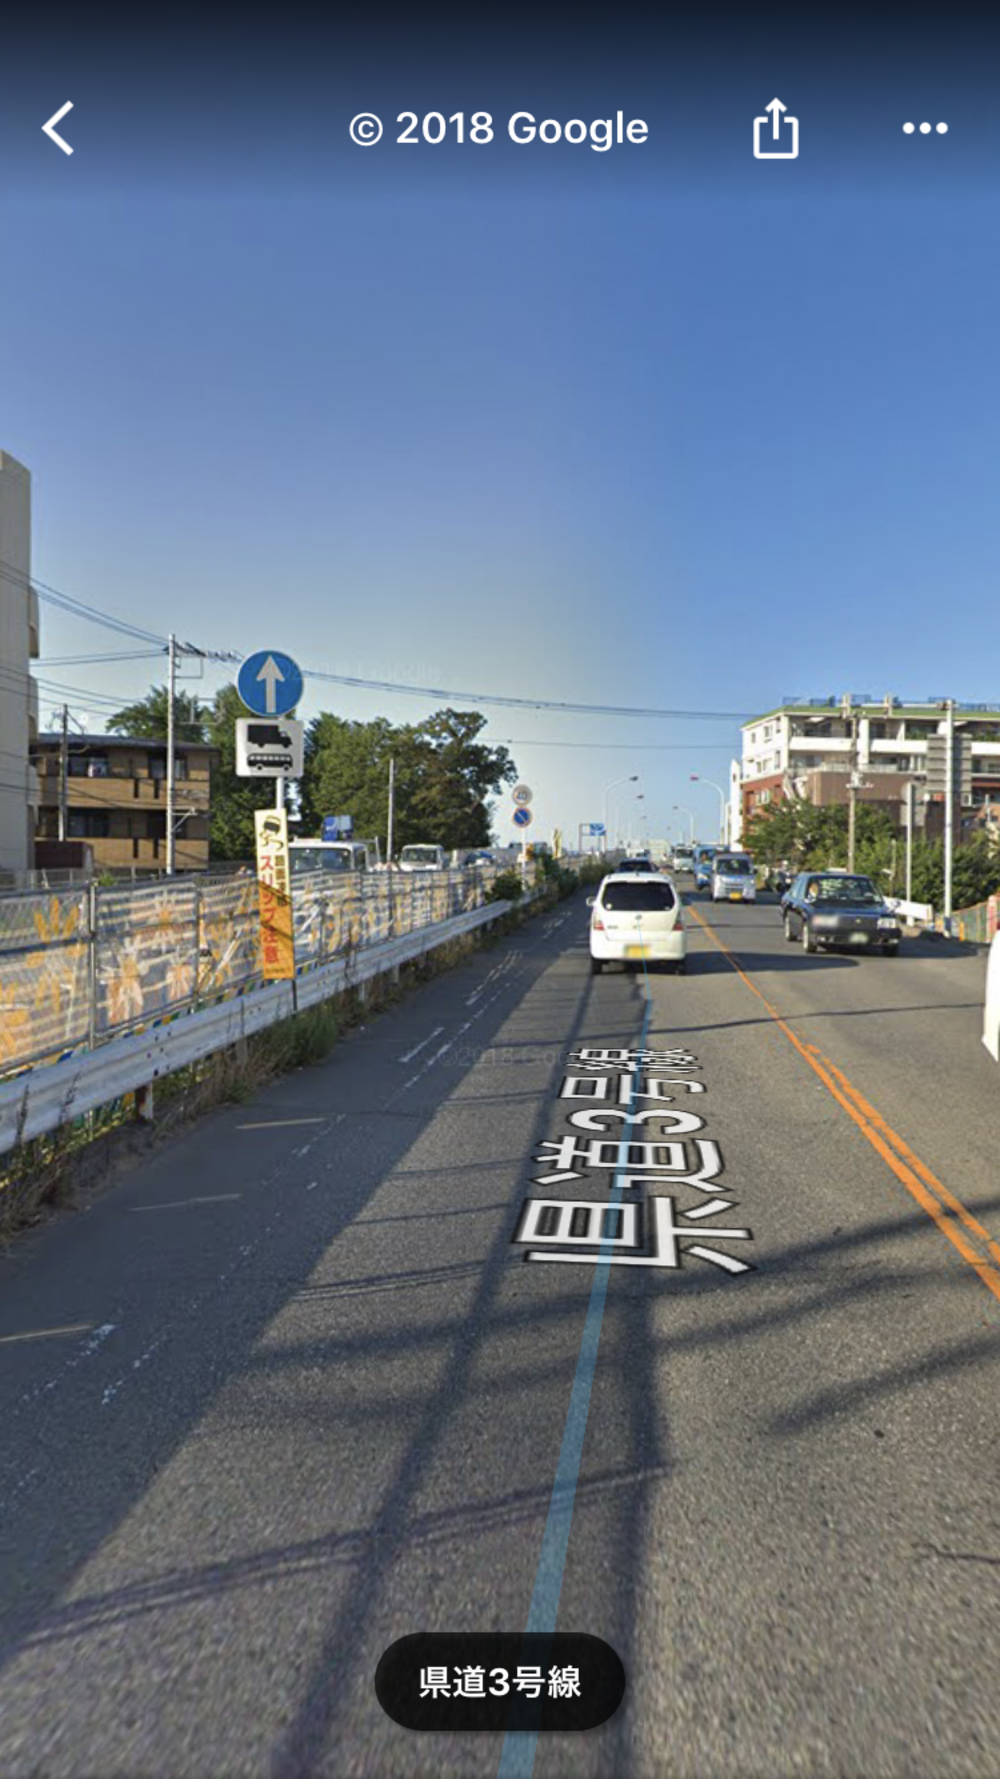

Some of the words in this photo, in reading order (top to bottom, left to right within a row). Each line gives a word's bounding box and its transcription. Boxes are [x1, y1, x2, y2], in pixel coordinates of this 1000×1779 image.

[260, 854, 279, 963] スリップ注意
